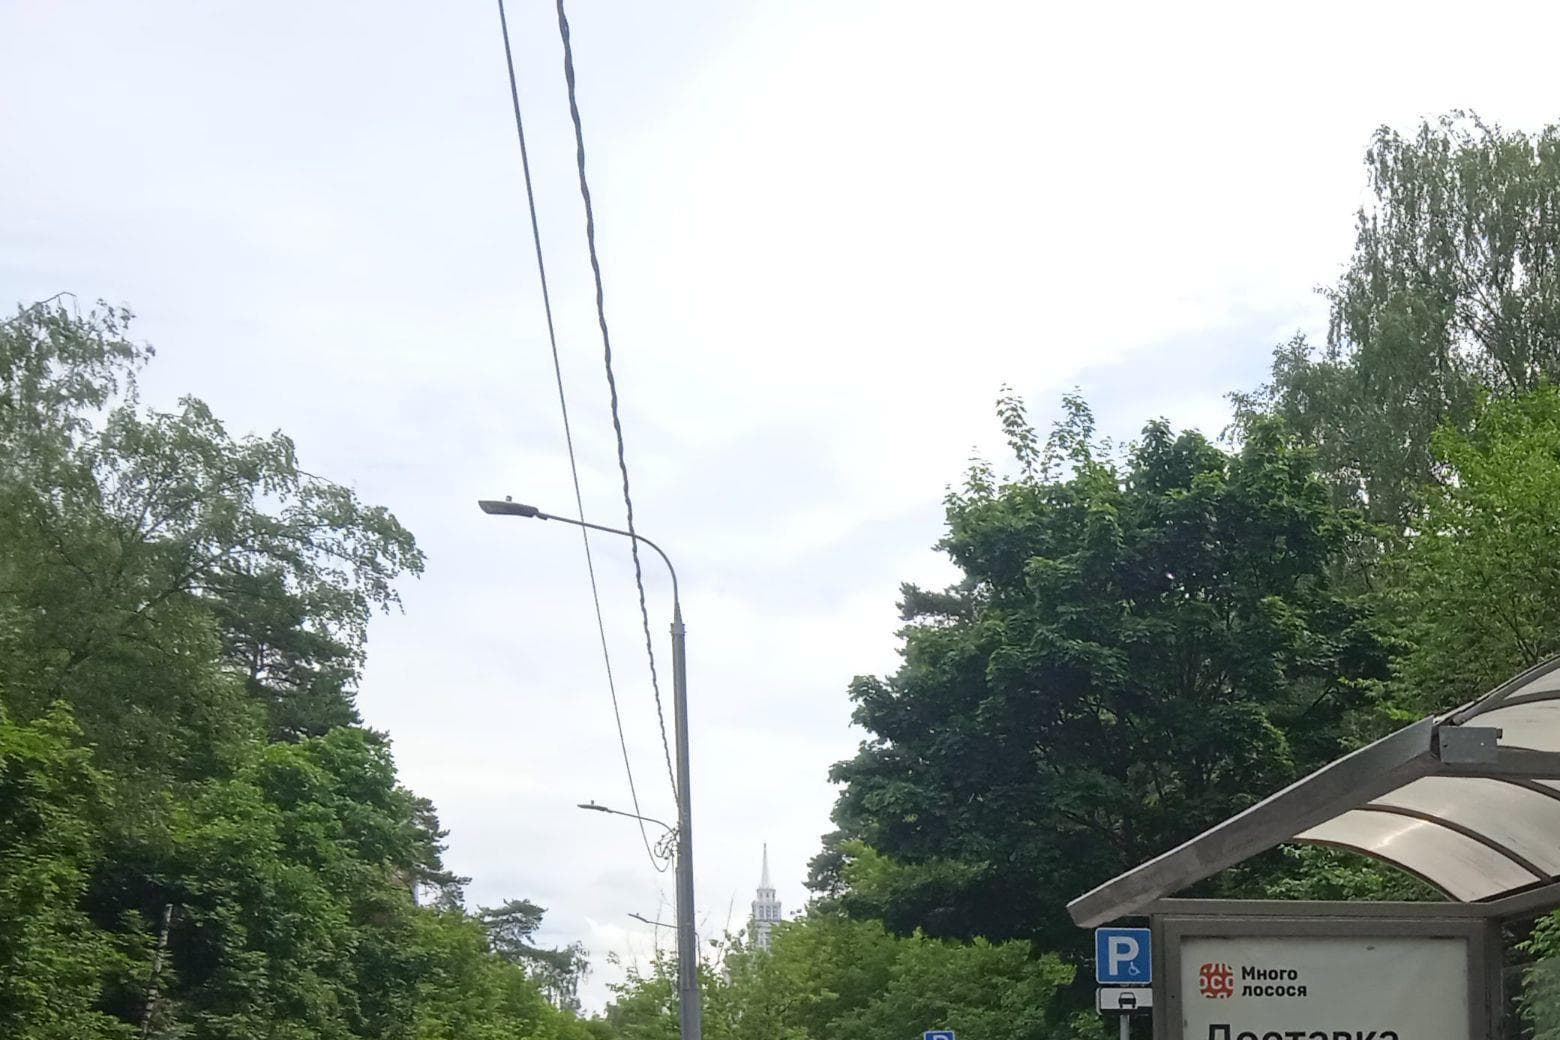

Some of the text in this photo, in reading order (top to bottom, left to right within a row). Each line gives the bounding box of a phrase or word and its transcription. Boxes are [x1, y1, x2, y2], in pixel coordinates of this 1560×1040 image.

[1108, 936, 1140, 976] P
[1241, 965, 1298, 981] Много
[1241, 984, 1308, 998] лосося
